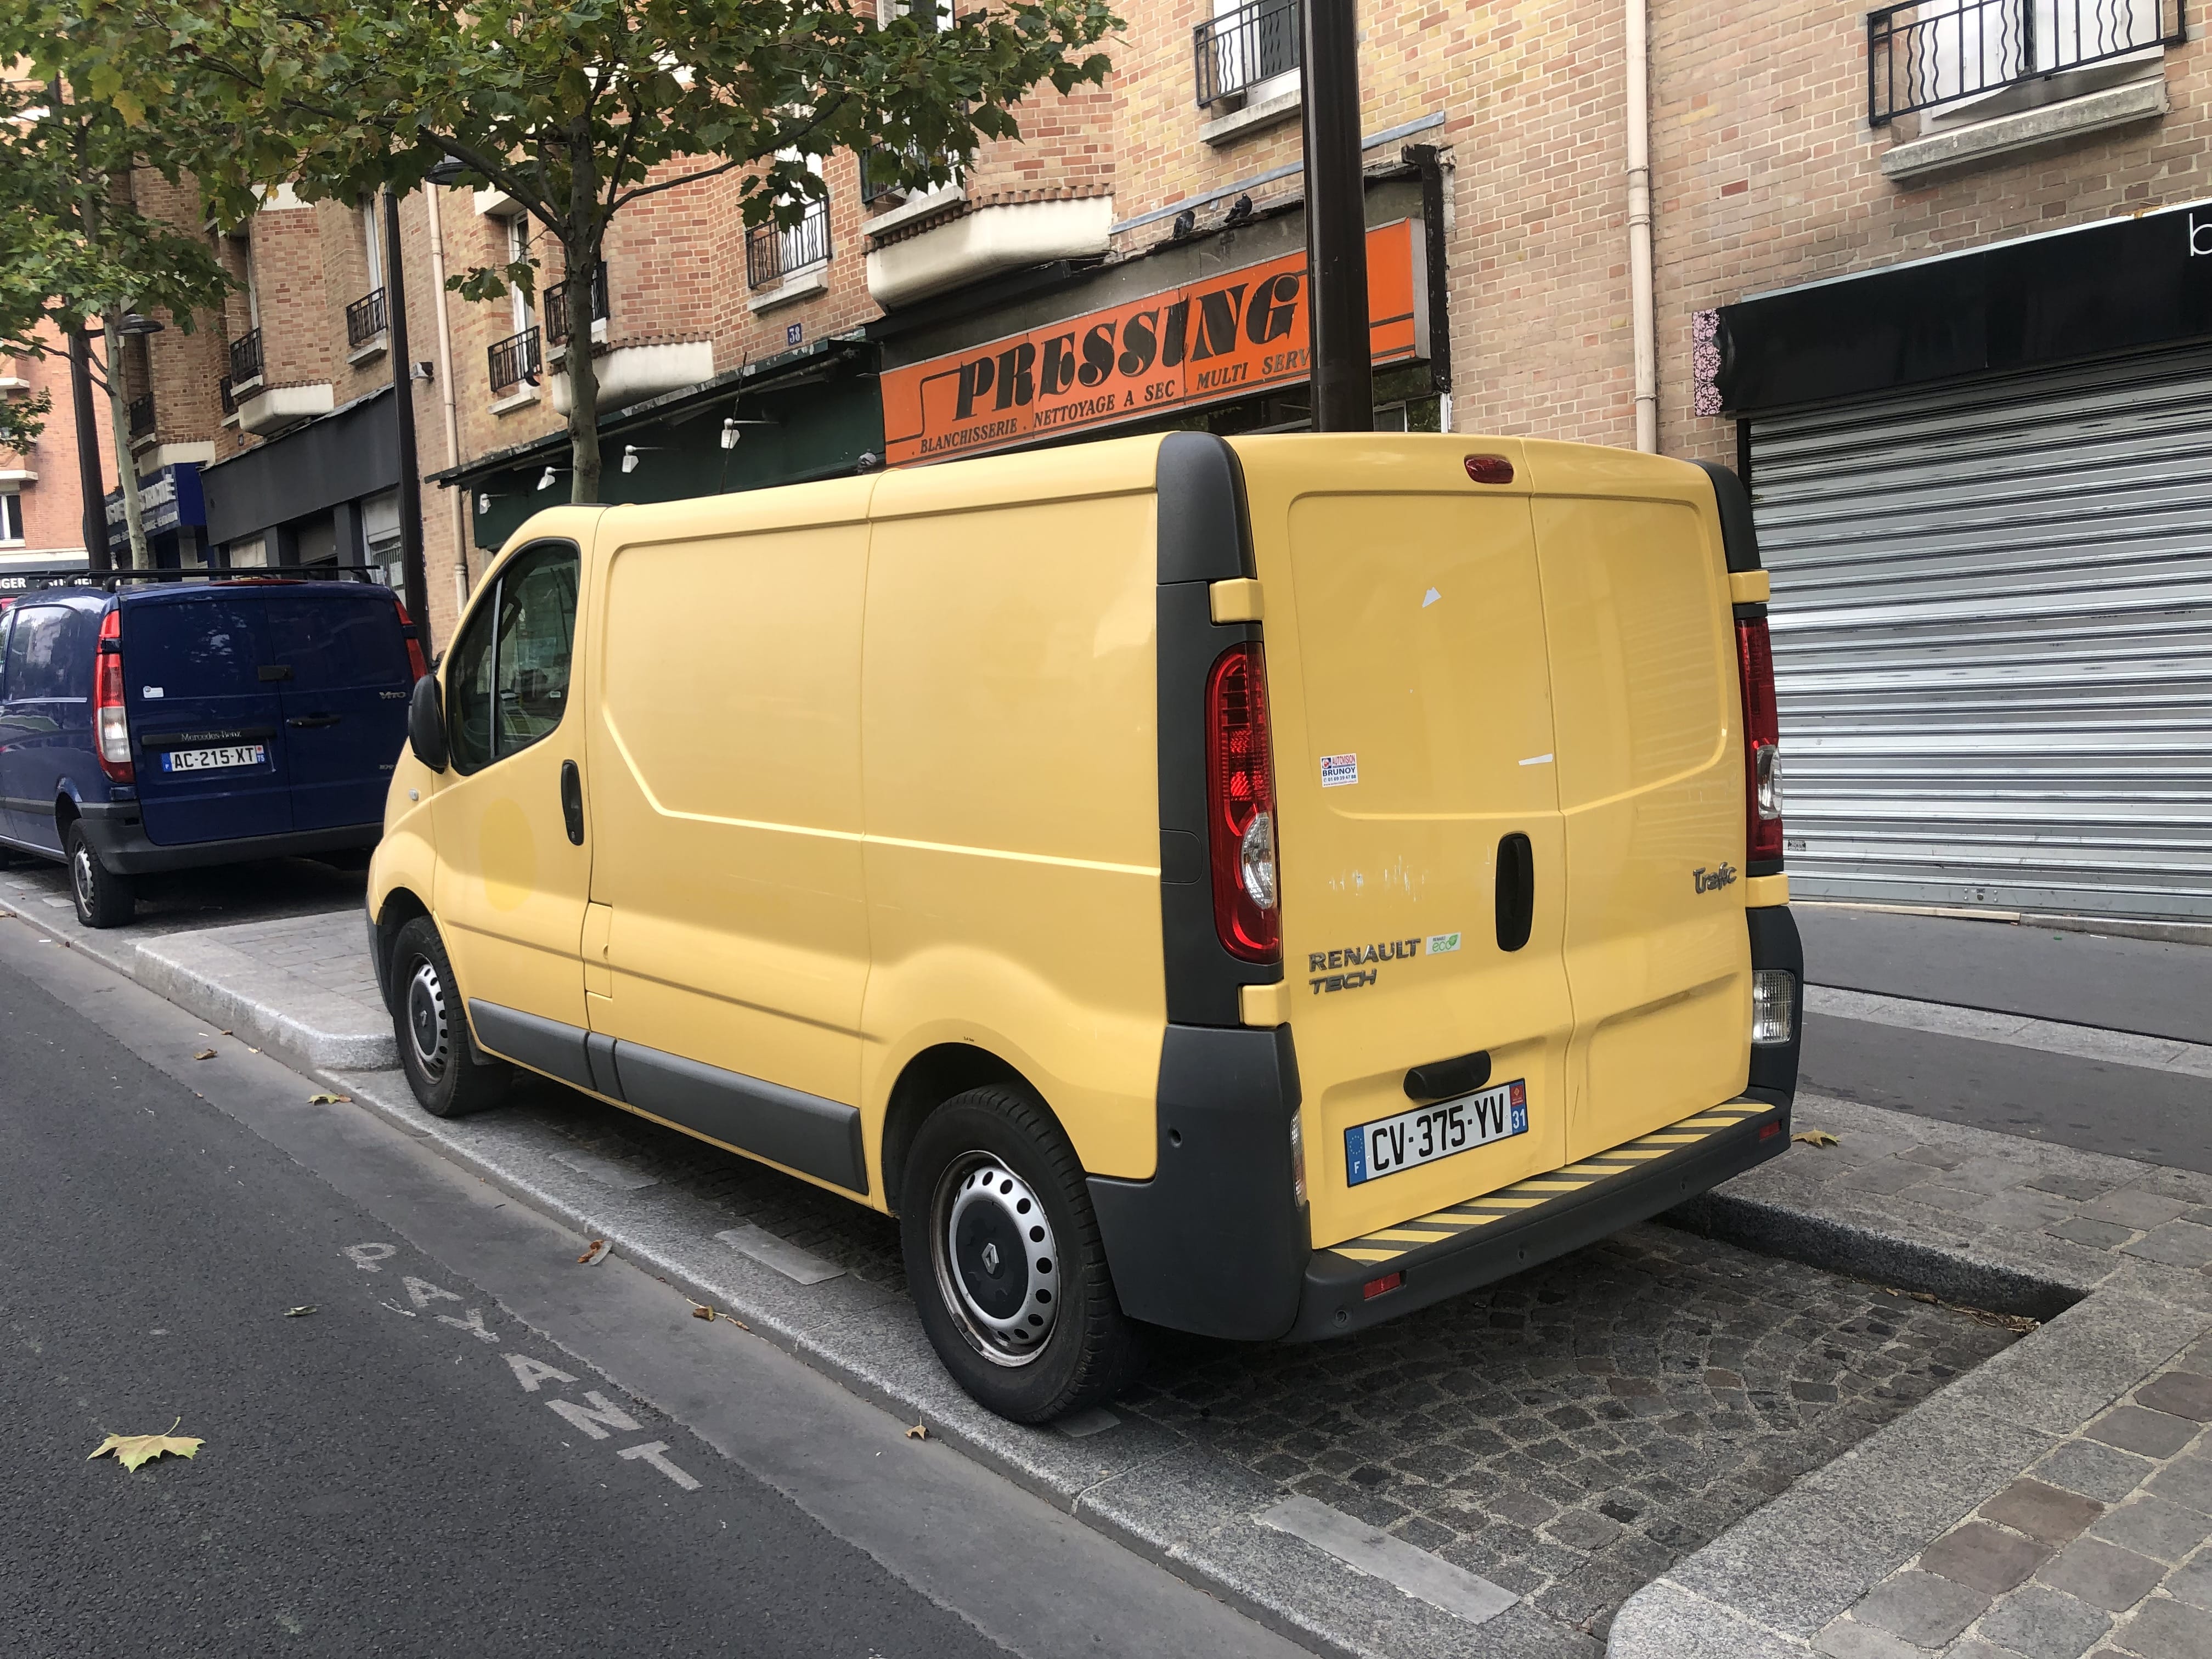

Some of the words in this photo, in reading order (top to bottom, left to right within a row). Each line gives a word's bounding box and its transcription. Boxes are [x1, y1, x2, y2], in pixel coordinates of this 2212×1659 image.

[789, 326, 800, 343] 38
[952, 272, 1299, 421] PRESSING
[921, 419, 1017, 453] BLANCHISSERIE
[1034, 394, 1115, 428] NETTOYAGE
[1124, 390, 1135, 407] A
[1144, 380, 1175, 402] SEC
[1197, 362, 1248, 391] MULTI
[0, 577, 26, 589] GER
[181, 730, 242, 741] Mercedes-Benz
[174, 747, 254, 769] AC-215-XT
[1333, 754, 1356, 765] AUTOVISION
[1323, 767, 1356, 776] BRUNOY
[1693, 862, 1737, 894] Trafic
[1308, 938, 1421, 972] RENAULT
[1432, 941, 1452, 952] eco
[1309, 968, 1377, 995] TECH
[1354, 1160, 1361, 1175] F
[1372, 1093, 1504, 1171] CV-375-YV
[1513, 1108, 1526, 1129] 31
[341, 1242, 703, 1491] PAYANT
